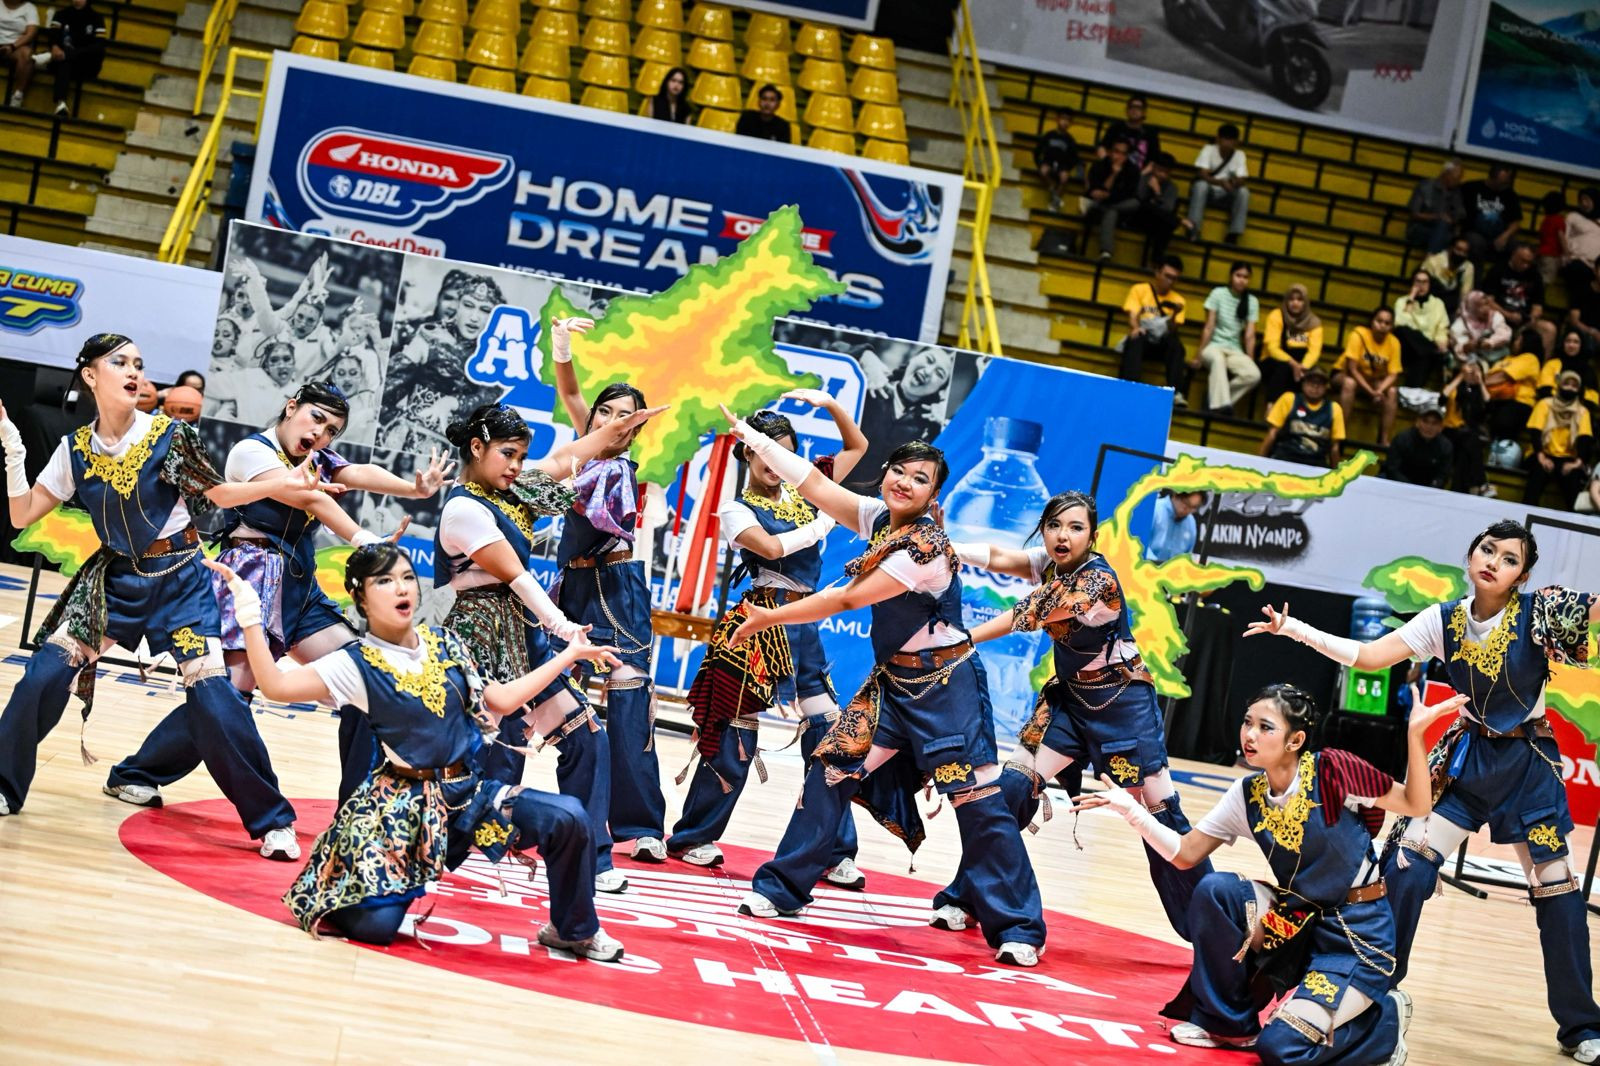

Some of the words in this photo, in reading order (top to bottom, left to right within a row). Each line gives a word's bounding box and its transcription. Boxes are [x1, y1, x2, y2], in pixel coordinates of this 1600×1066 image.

[358, 151, 460, 183] HONDA
[351, 179, 401, 207] DBL
[513, 169, 713, 237] HOME
[12, 272, 78, 298] CUMA
[506, 210, 884, 310] DREAS
[692, 957, 1178, 1054] HEART.
